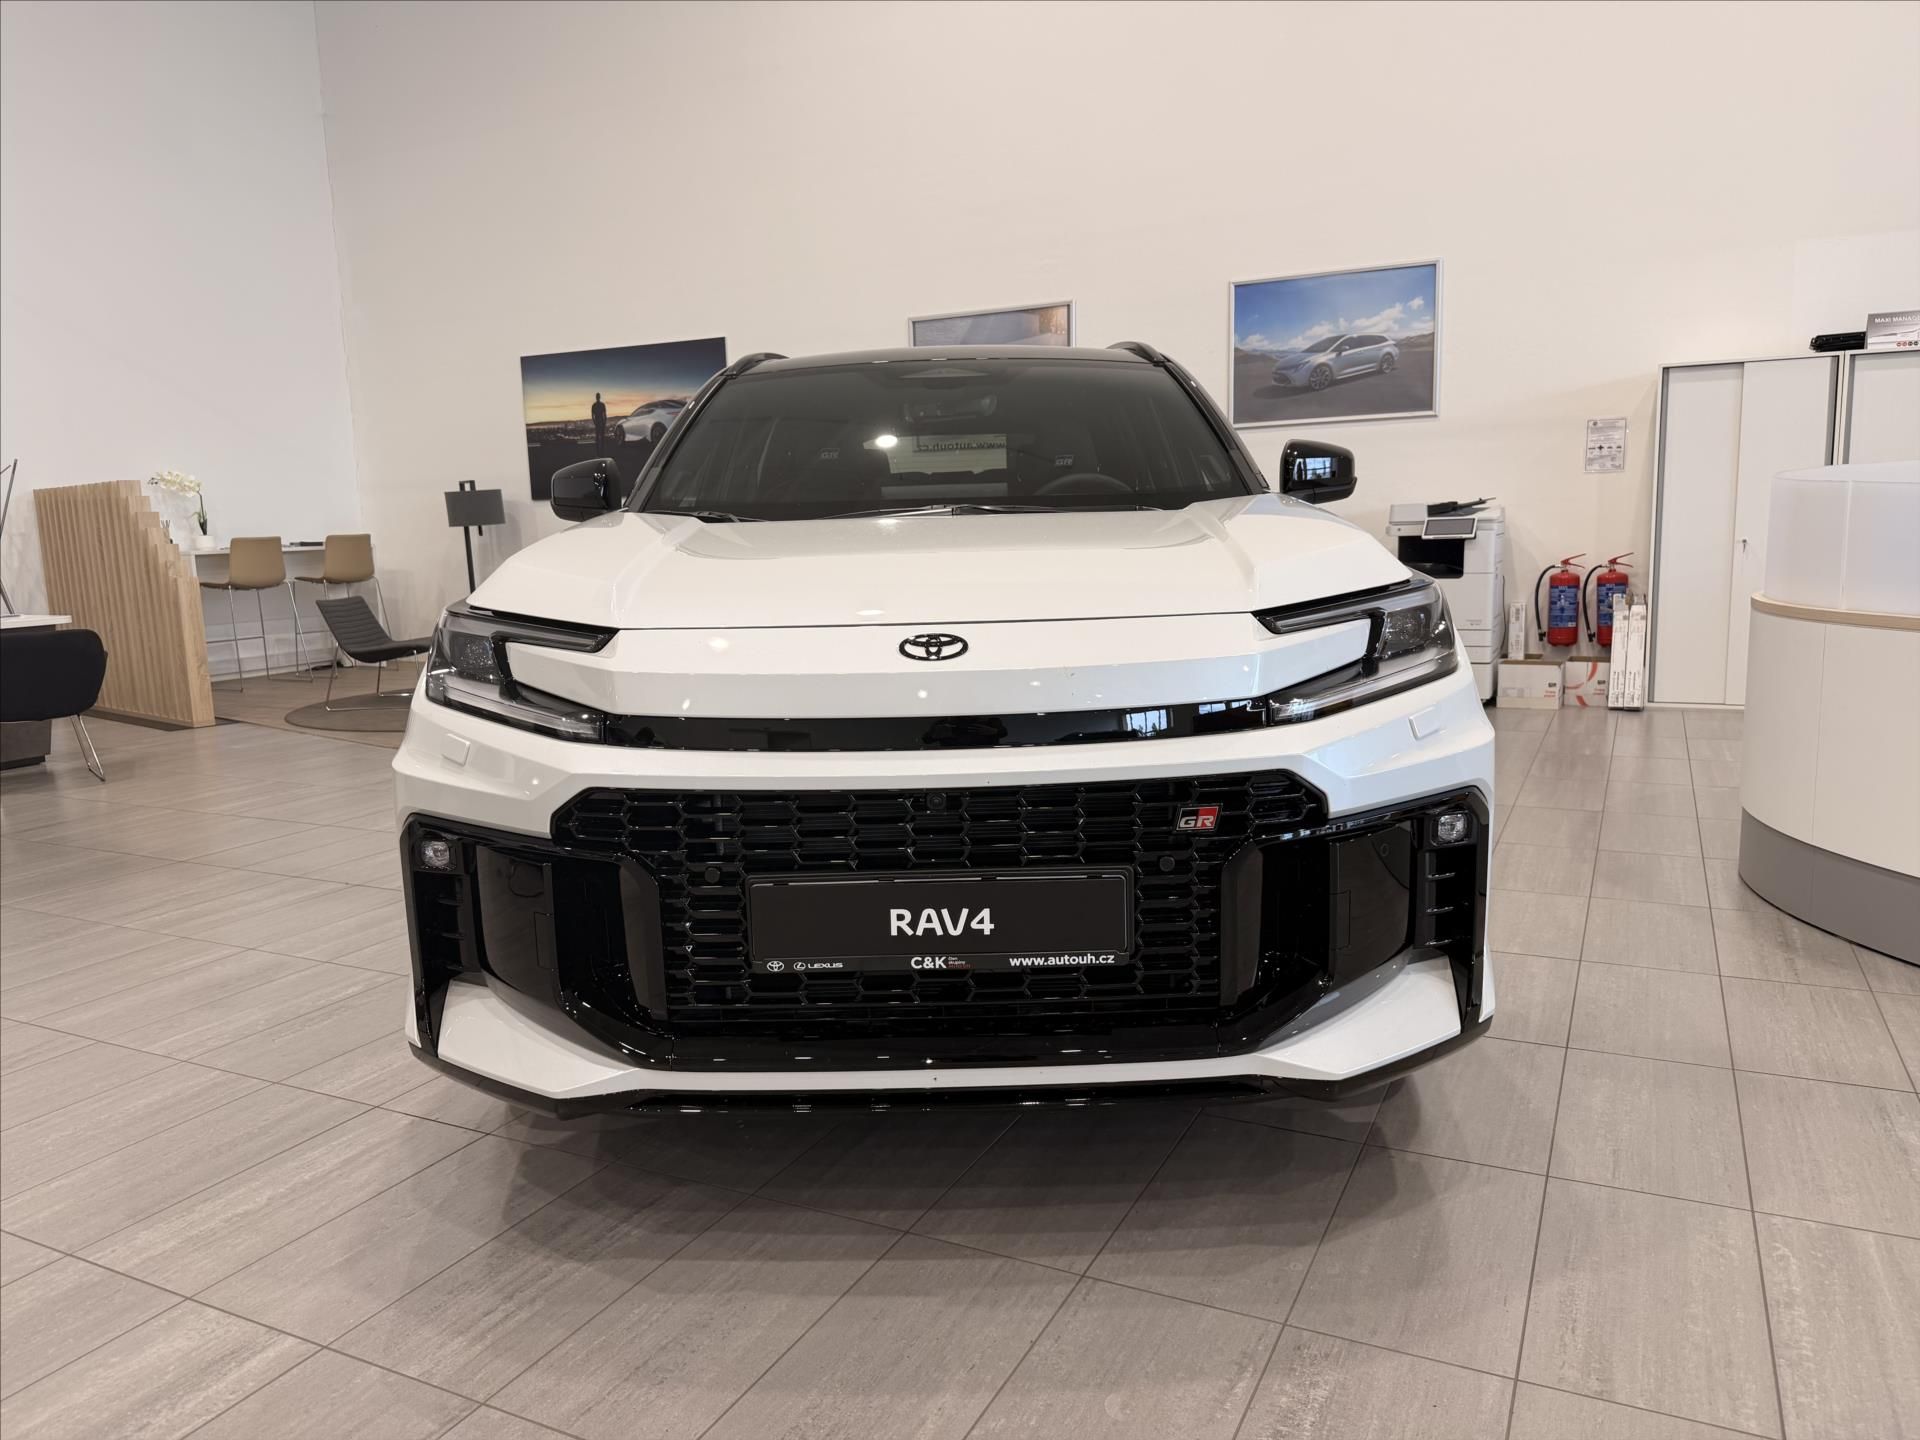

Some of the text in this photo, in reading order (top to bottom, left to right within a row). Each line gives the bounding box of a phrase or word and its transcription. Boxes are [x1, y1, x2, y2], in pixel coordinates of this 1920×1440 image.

[1179, 815, 1214, 828] GR
[889, 907, 995, 937] RAV4
[910, 956, 947, 969] C&K
[1009, 952, 1115, 968] www.autouh.cz
